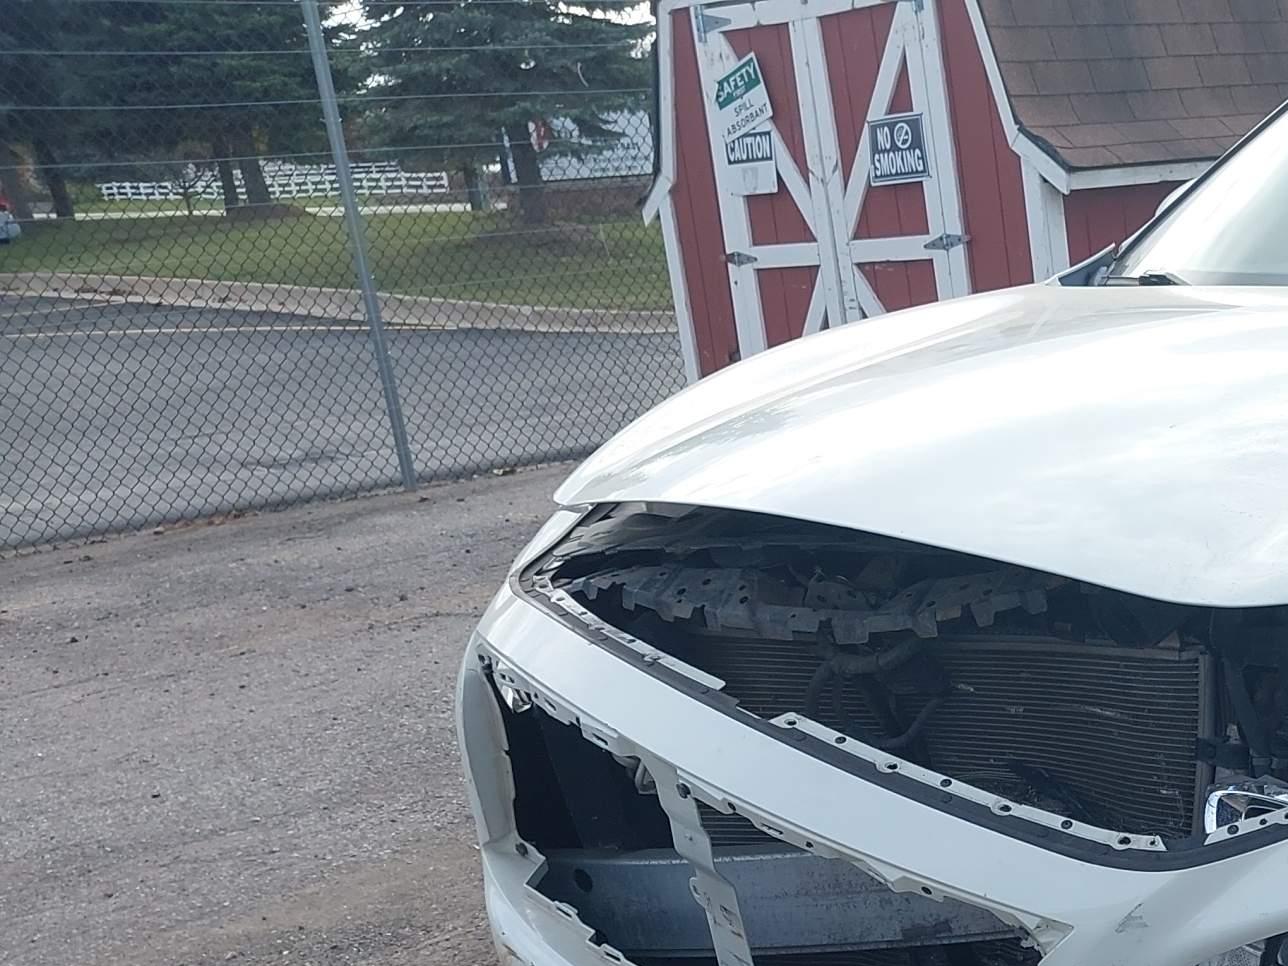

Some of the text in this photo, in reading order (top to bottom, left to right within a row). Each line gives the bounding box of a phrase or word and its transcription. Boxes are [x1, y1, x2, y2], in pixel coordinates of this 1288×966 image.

[717, 62, 756, 103] SAFETY
[727, 103, 768, 138] ABSORBANT
[734, 99, 754, 117] SPILL
[727, 134, 771, 162] CAUTION
[876, 126, 891, 151] NO
[873, 148, 924, 177] SMOKING
